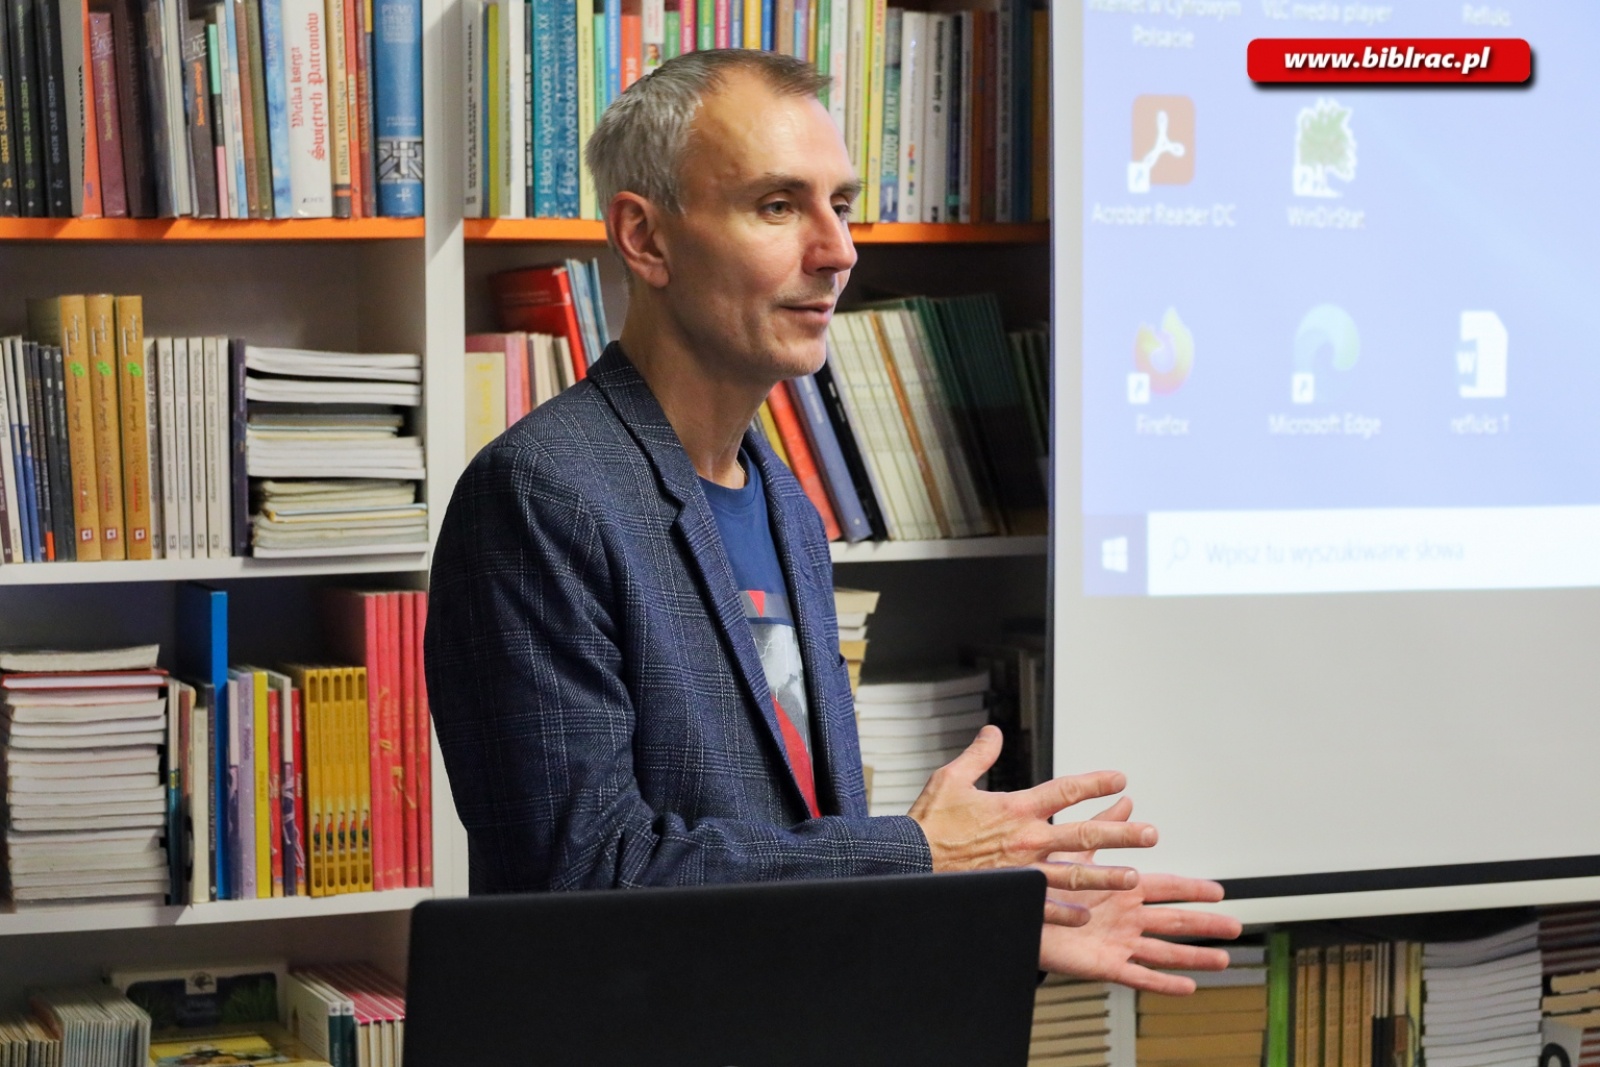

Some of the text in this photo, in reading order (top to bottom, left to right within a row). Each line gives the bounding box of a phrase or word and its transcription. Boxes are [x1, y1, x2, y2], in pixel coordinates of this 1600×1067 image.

[1292, 2, 1339, 22] media
[1341, 5, 1393, 27] player
[290, 46, 304, 128] Wielka księga
[306, 12, 327, 160] Świętych Patronów
[537, 14, 555, 194] Historia wychowania wiek XX
[563, 15, 577, 195] Historia wychowania wiek XX
[337, 81, 348, 133] Mitologia
[340, 145, 349, 175] Biblia
[1212, 204, 1237, 227] DC
[1136, 413, 1190, 434] Firefox
[1269, 413, 1382, 438] Microsoft Edge
